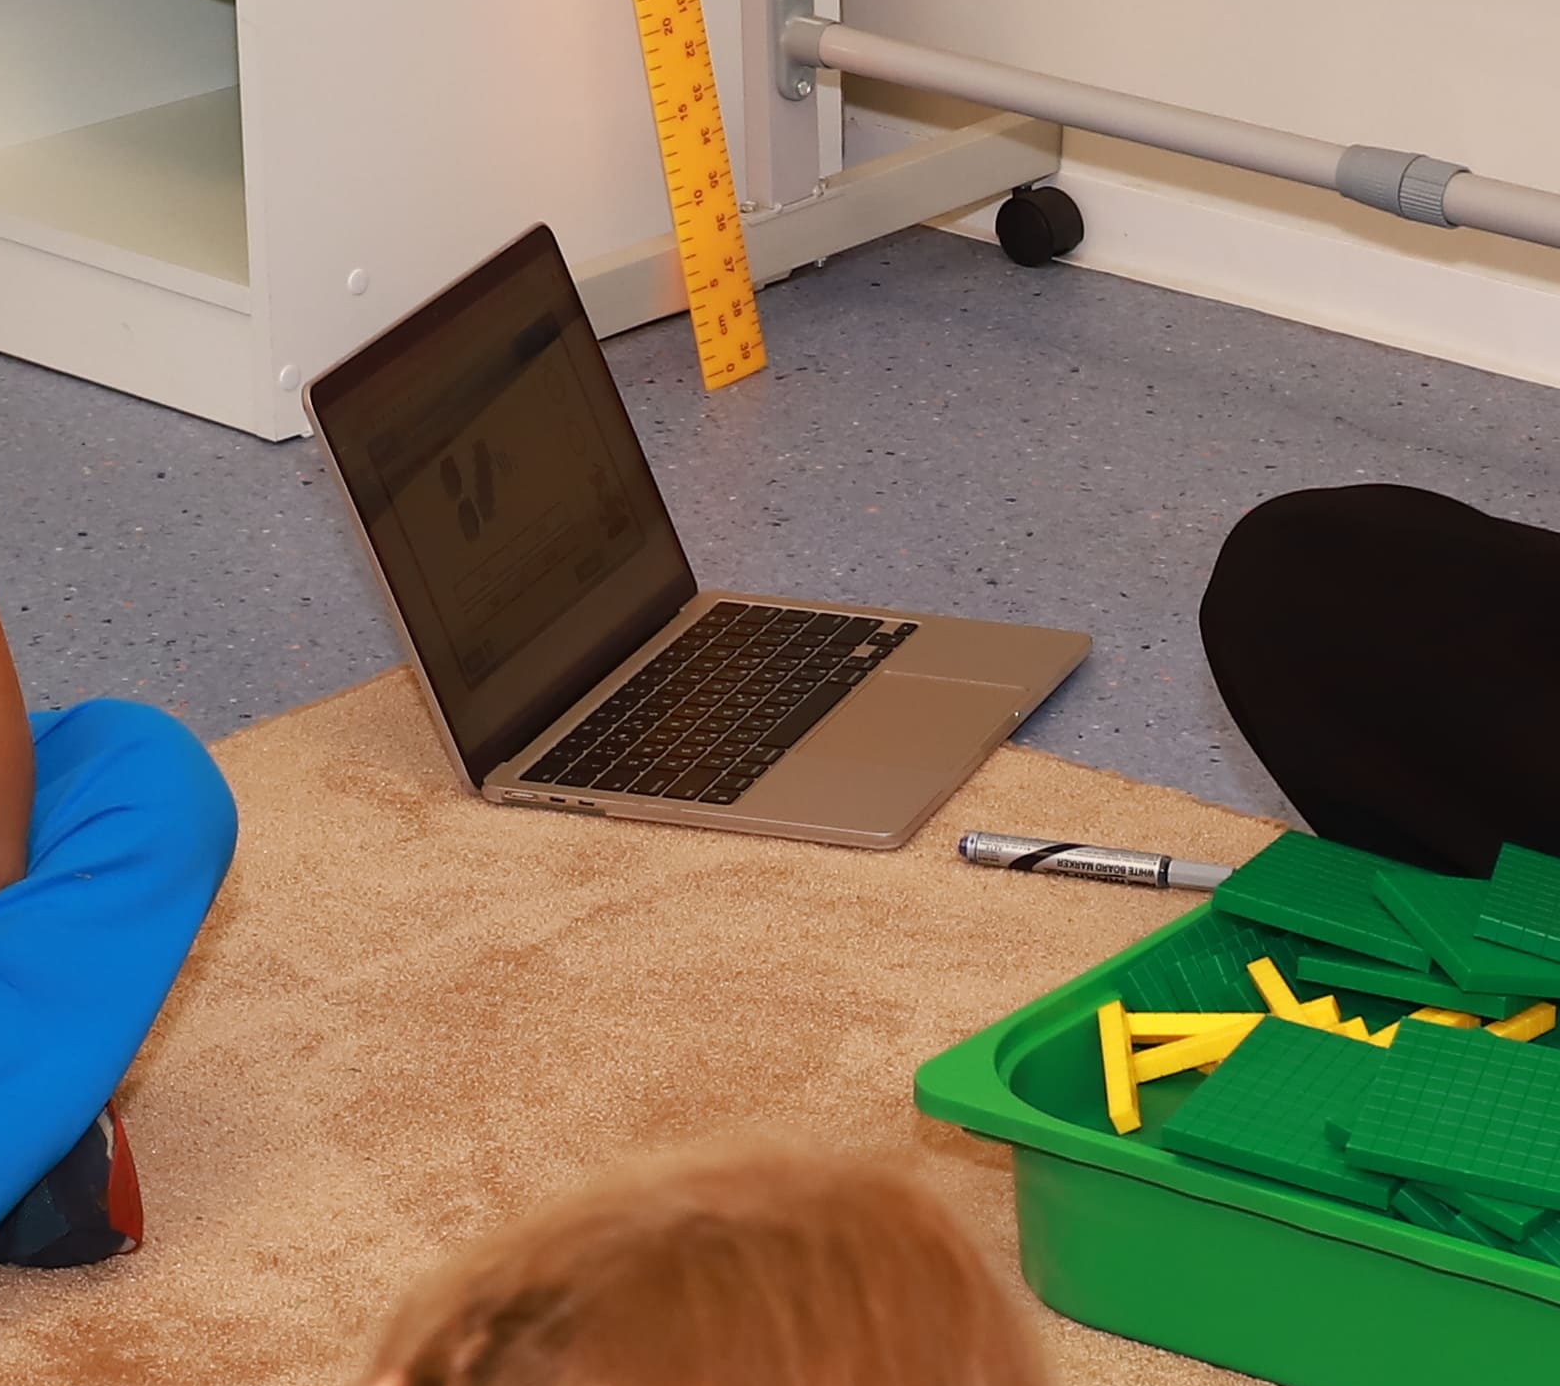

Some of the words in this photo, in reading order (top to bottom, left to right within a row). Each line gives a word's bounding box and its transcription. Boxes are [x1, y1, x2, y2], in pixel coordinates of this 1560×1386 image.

[662, 18, 673, 36] 20
[678, 104, 688, 121] 15
[694, 190, 703, 206] 10
[710, 279, 718, 288] 5
[718, 314, 728, 335] cm
[726, 363, 735, 372] 0
[685, 40, 696, 58] 32
[693, 84, 703, 102] 33
[701, 128, 711, 145] 34
[708, 171, 719, 189] 35
[716, 213, 726, 231] 36
[724, 257, 735, 272] 37
[732, 300, 742, 317] 38
[740, 342, 750, 360] 39
[1056, 857, 1094, 873] MARKER
[1095, 862, 1127, 876] BOARD
[1131, 866, 1156, 879] WHITE
